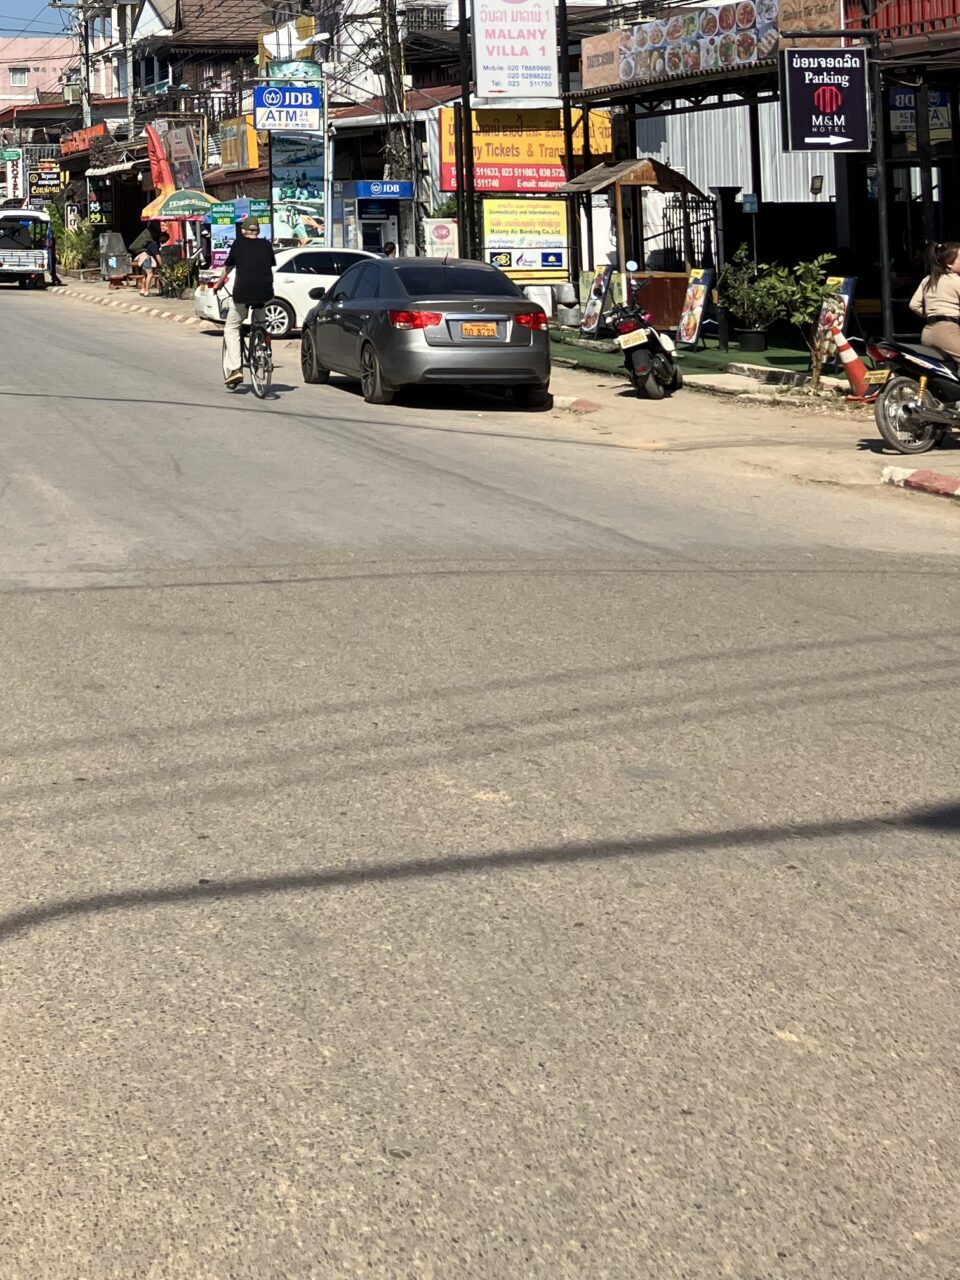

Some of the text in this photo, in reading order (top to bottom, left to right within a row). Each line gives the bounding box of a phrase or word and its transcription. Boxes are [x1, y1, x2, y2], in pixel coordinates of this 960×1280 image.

[484, 28, 547, 40] MALANY
[486, 45, 546, 57] VILLA 1
[804, 71, 850, 88] Parking
[283, 92, 313, 106] JDB
[265, 110, 297, 122] ATM
[811, 114, 845, 126] M&M
[485, 142, 520, 157] Tickets
[527, 143, 534, 158] &
[11, 160, 20, 198] HOTEL
[383, 184, 400, 193] JDB
